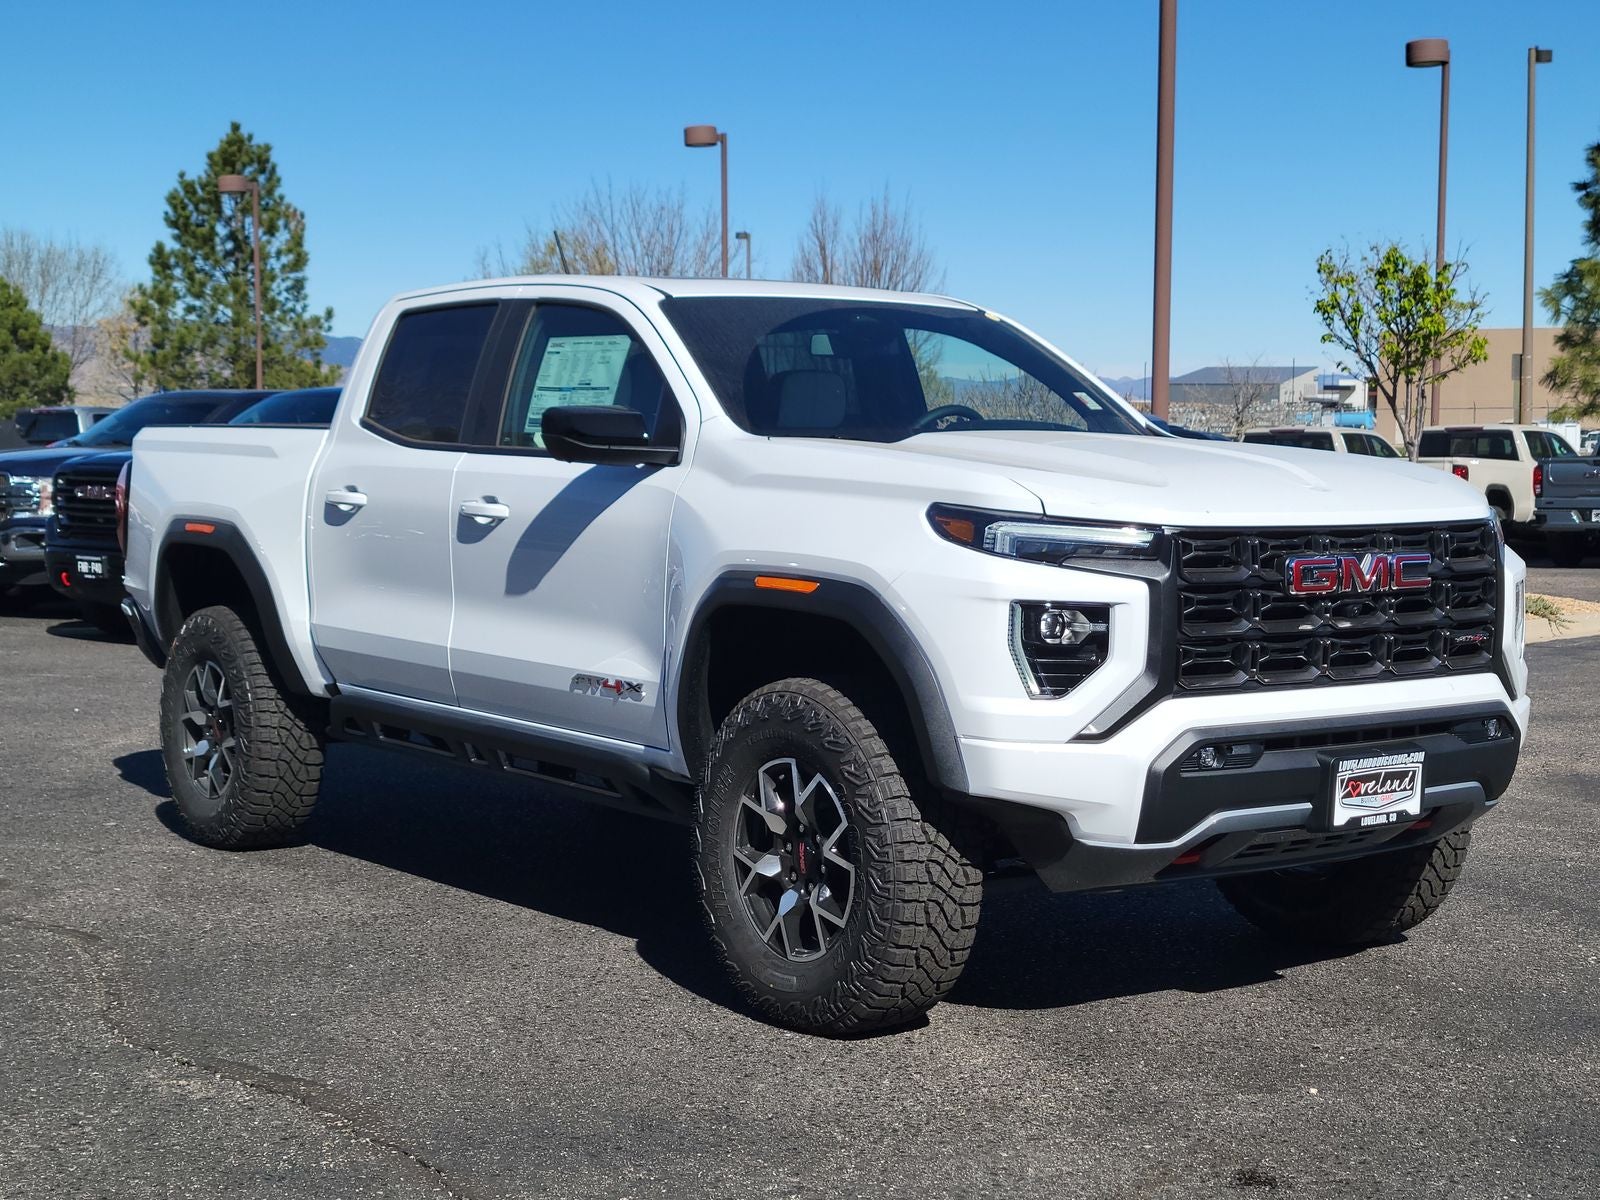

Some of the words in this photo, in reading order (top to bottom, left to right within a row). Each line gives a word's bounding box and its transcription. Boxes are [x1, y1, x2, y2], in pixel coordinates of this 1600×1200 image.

[1285, 552, 1433, 595] GMC
[569, 673, 644, 699] AT4X
[1389, 813, 1397, 822] CO
